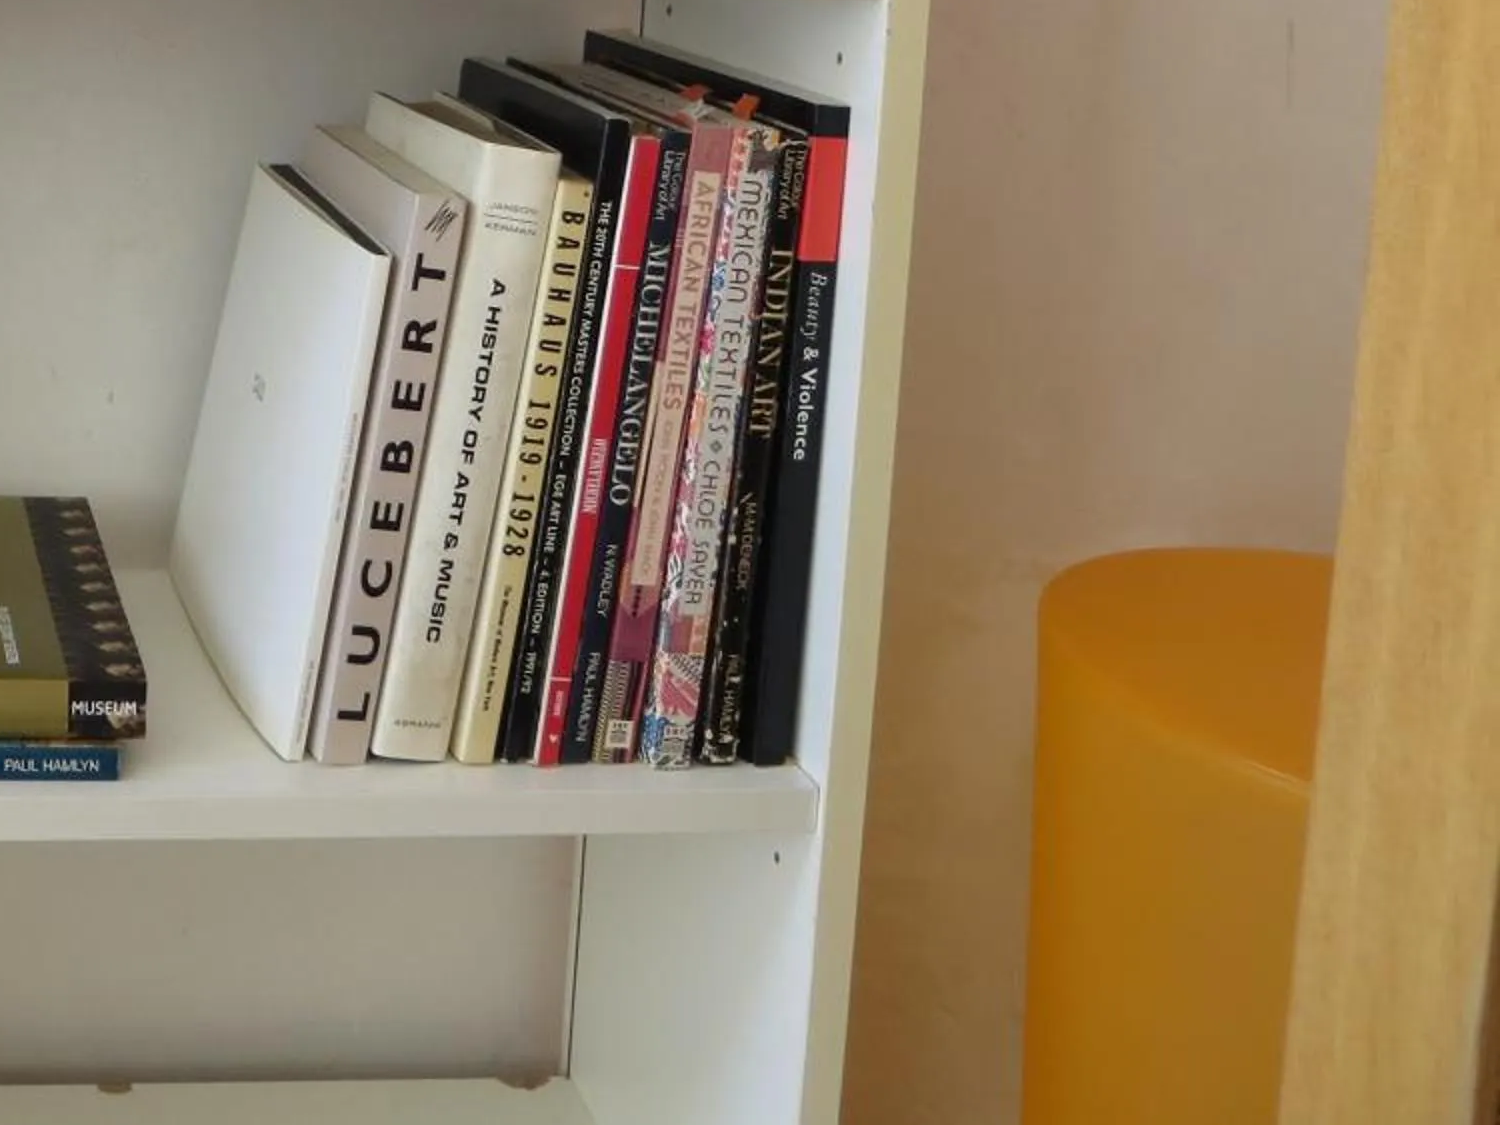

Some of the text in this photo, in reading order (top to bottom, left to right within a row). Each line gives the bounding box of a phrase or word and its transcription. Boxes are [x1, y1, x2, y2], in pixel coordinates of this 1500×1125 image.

[595, 227, 610, 258] 20TH
[601, 201, 613, 225] THE
[727, 179, 764, 303] MEXICAN
[534, 210, 585, 378] BAUHAUS
[582, 260, 606, 316] CENTURY
[662, 180, 717, 411] AFRICAN TEXTILES
[572, 318, 594, 375] MASTERS
[609, 241, 671, 506] MICHELANGELO
[710, 313, 745, 434] TEXTILES
[749, 249, 794, 439] INDIAN ART
[793, 272, 827, 461] Beauty & Violence
[561, 377, 583, 456] COLLECTION
[337, 252, 447, 722] LUCEBERT
[426, 278, 507, 644] A HISTORY OF ART & MUSIC
[543, 524, 558, 552] LINE
[532, 581, 549, 635] EDITION
[597, 559, 616, 617] WADLEY
[583, 652, 601, 685] PAUL
[71, 700, 137, 716] MUSEUM
[4, 759, 100, 773] PAUL HAMLYN
